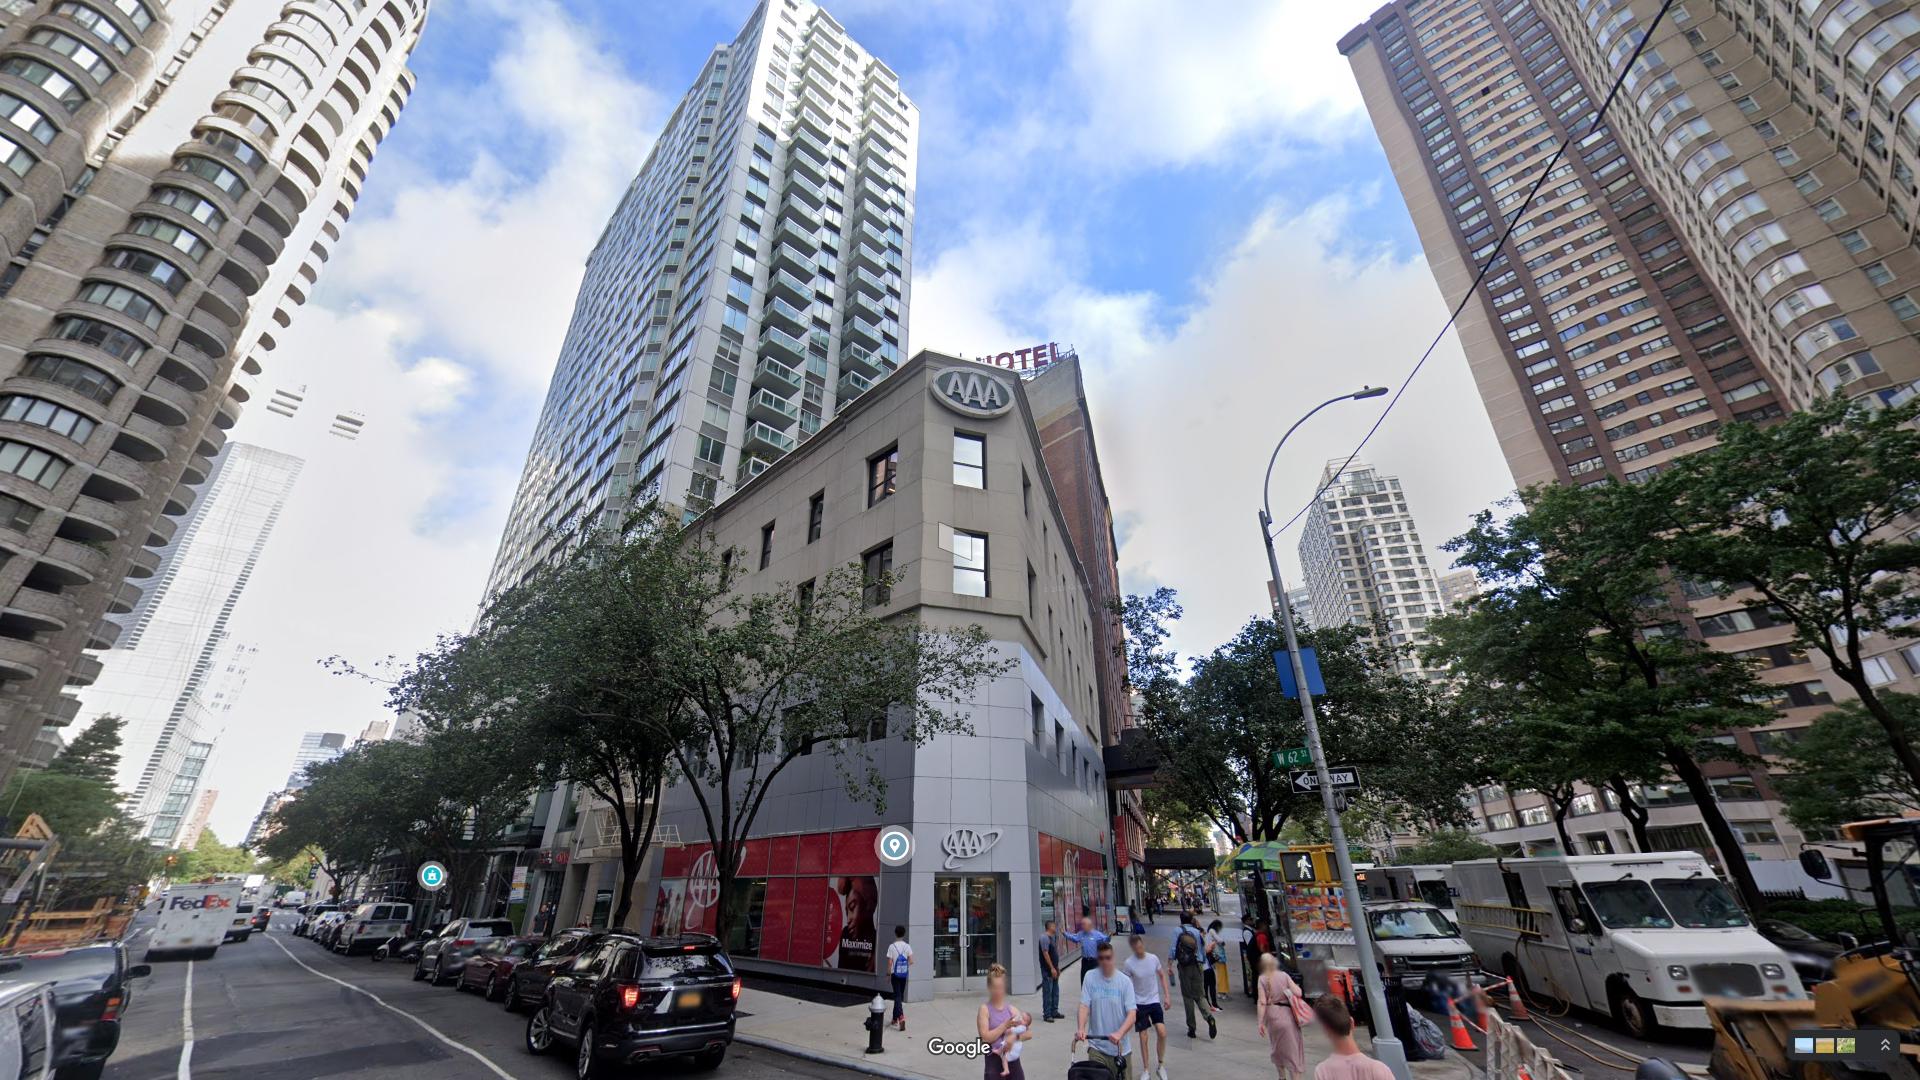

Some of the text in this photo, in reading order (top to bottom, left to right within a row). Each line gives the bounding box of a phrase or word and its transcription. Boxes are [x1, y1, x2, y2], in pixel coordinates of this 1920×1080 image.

[980, 342, 1057, 369] OTEL
[946, 371, 1002, 408] AAA
[1277, 753, 1285, 765] W
[1288, 750, 1299, 764] 62
[947, 829, 983, 857] AAA
[169, 894, 232, 911] FedEx
[842, 938, 873, 950] Maximize
